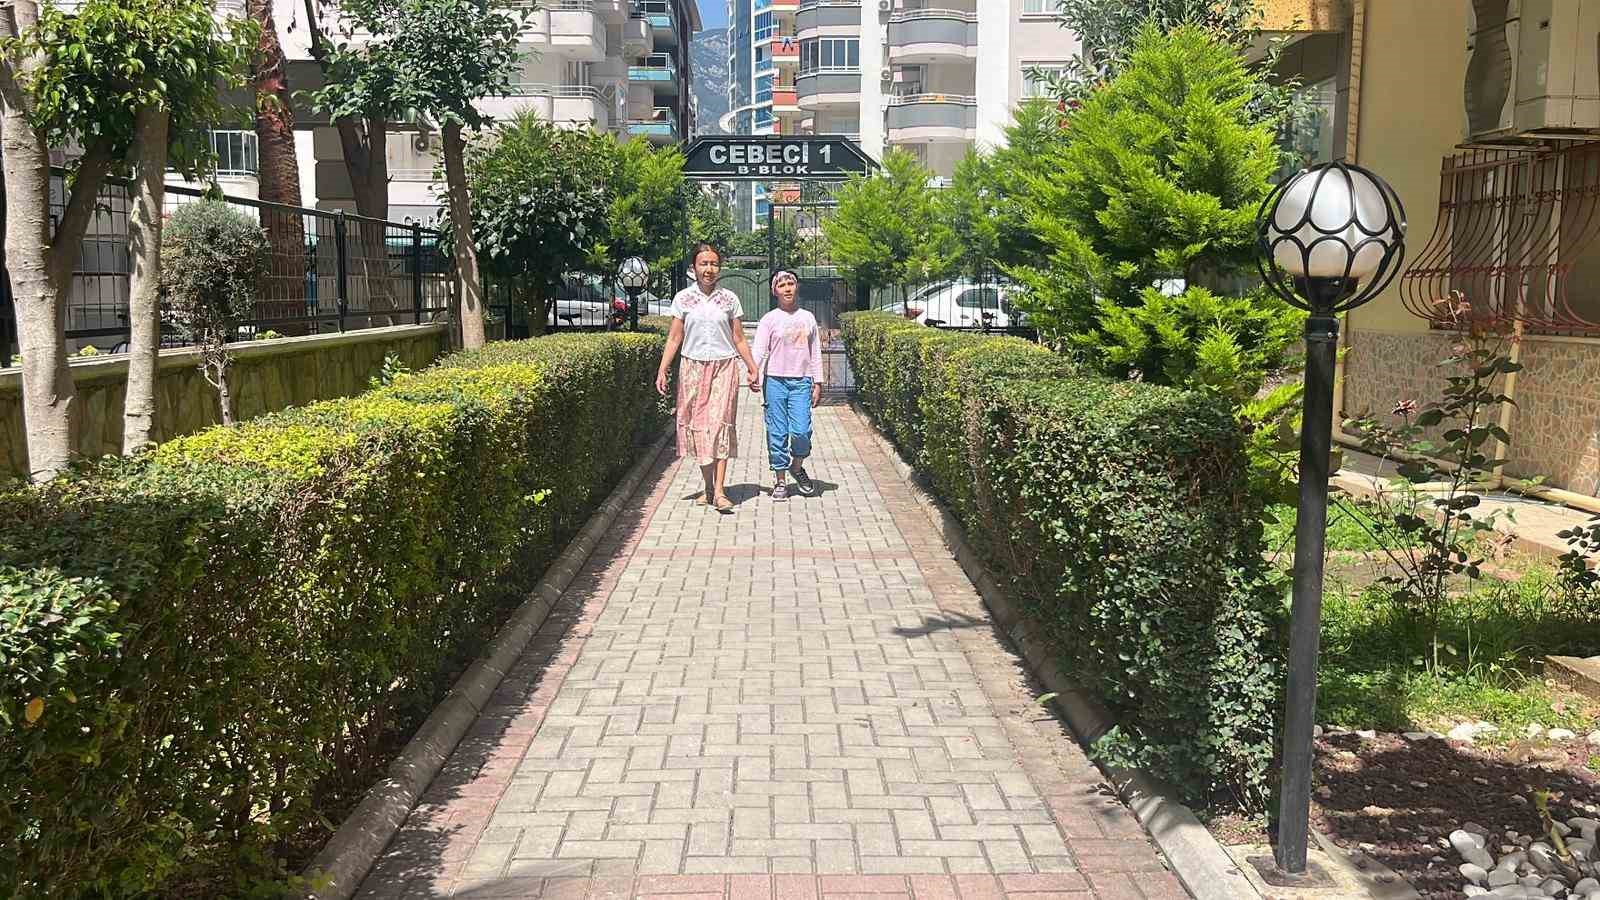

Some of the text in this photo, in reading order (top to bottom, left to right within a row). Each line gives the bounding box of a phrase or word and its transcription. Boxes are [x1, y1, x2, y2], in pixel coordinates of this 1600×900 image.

[709, 142, 831, 164] CEBECİ 1
[738, 165, 809, 175] B-BLOK
